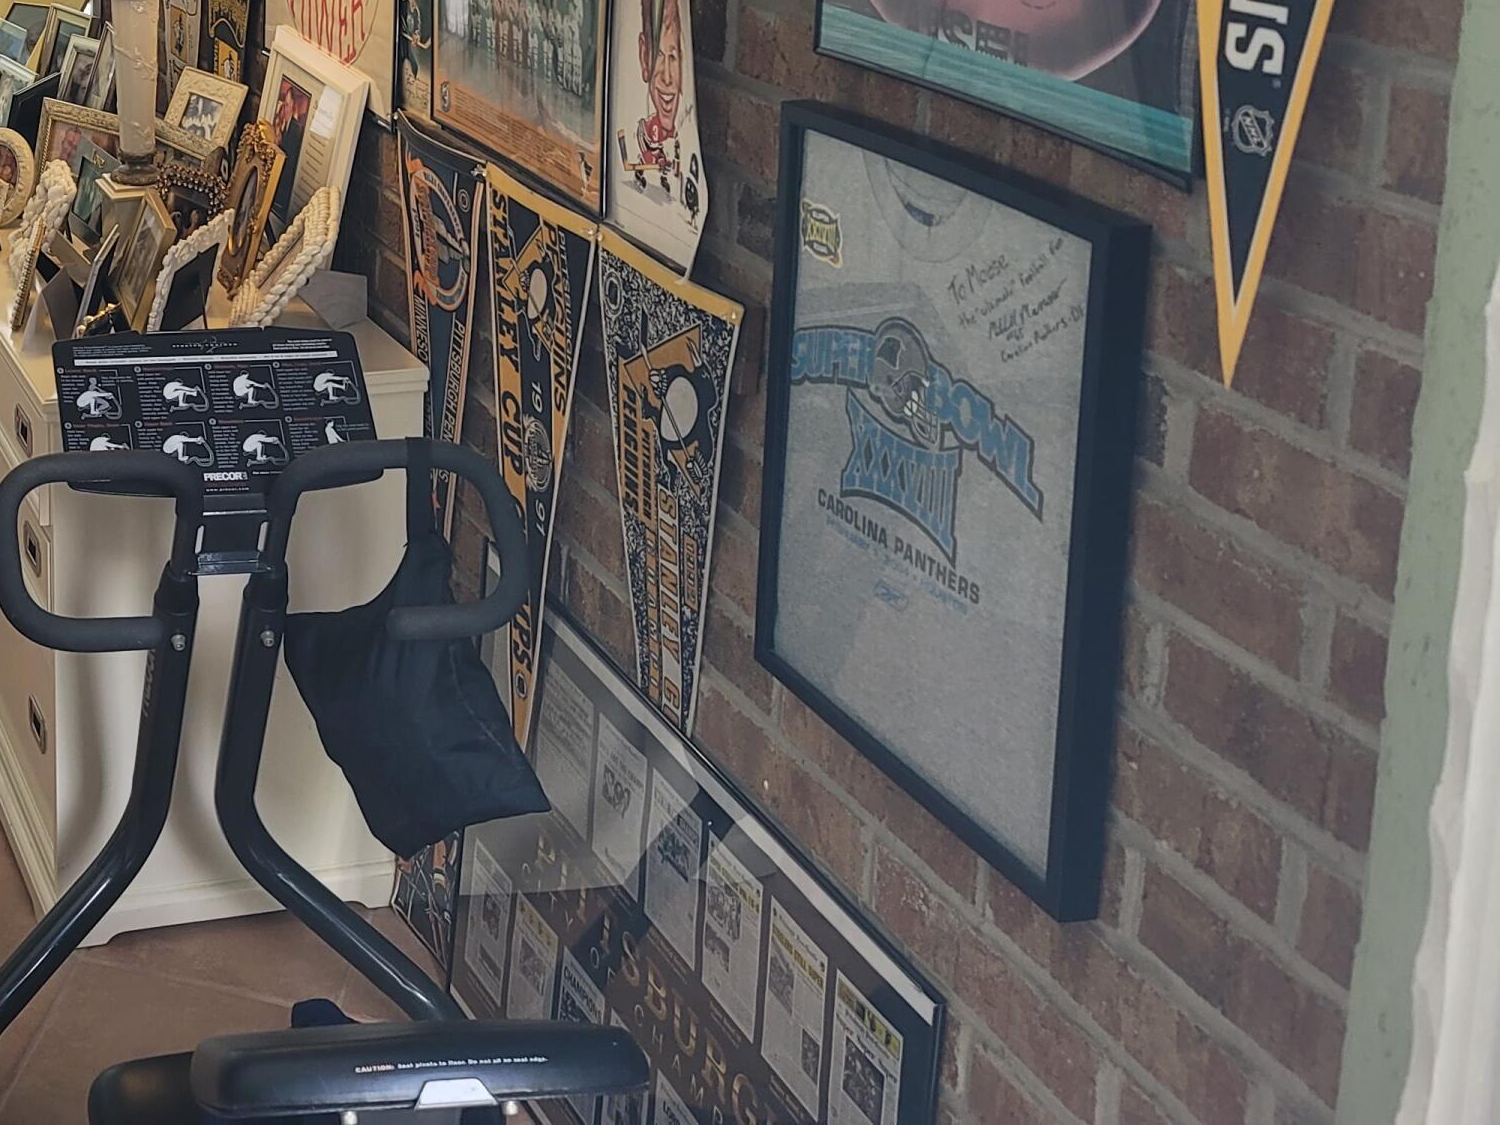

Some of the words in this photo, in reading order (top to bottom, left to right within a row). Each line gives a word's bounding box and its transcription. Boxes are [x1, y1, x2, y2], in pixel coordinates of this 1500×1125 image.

[1240, 110, 1263, 149] NHL
[414, 293, 429, 363] MINNESO
[446, 319, 466, 411] PITTSBURGH
[501, 390, 524, 476] CUP
[531, 381, 543, 414] 19
[791, 328, 876, 383] SUPER
[925, 361, 1043, 513] BOWL
[203, 471, 244, 482] PRECOR
[535, 499, 546, 537] 91
[817, 488, 889, 549] CAROLINA
[893, 535, 981, 605] PANTHERS
[659, 490, 681, 665] STANLEY
